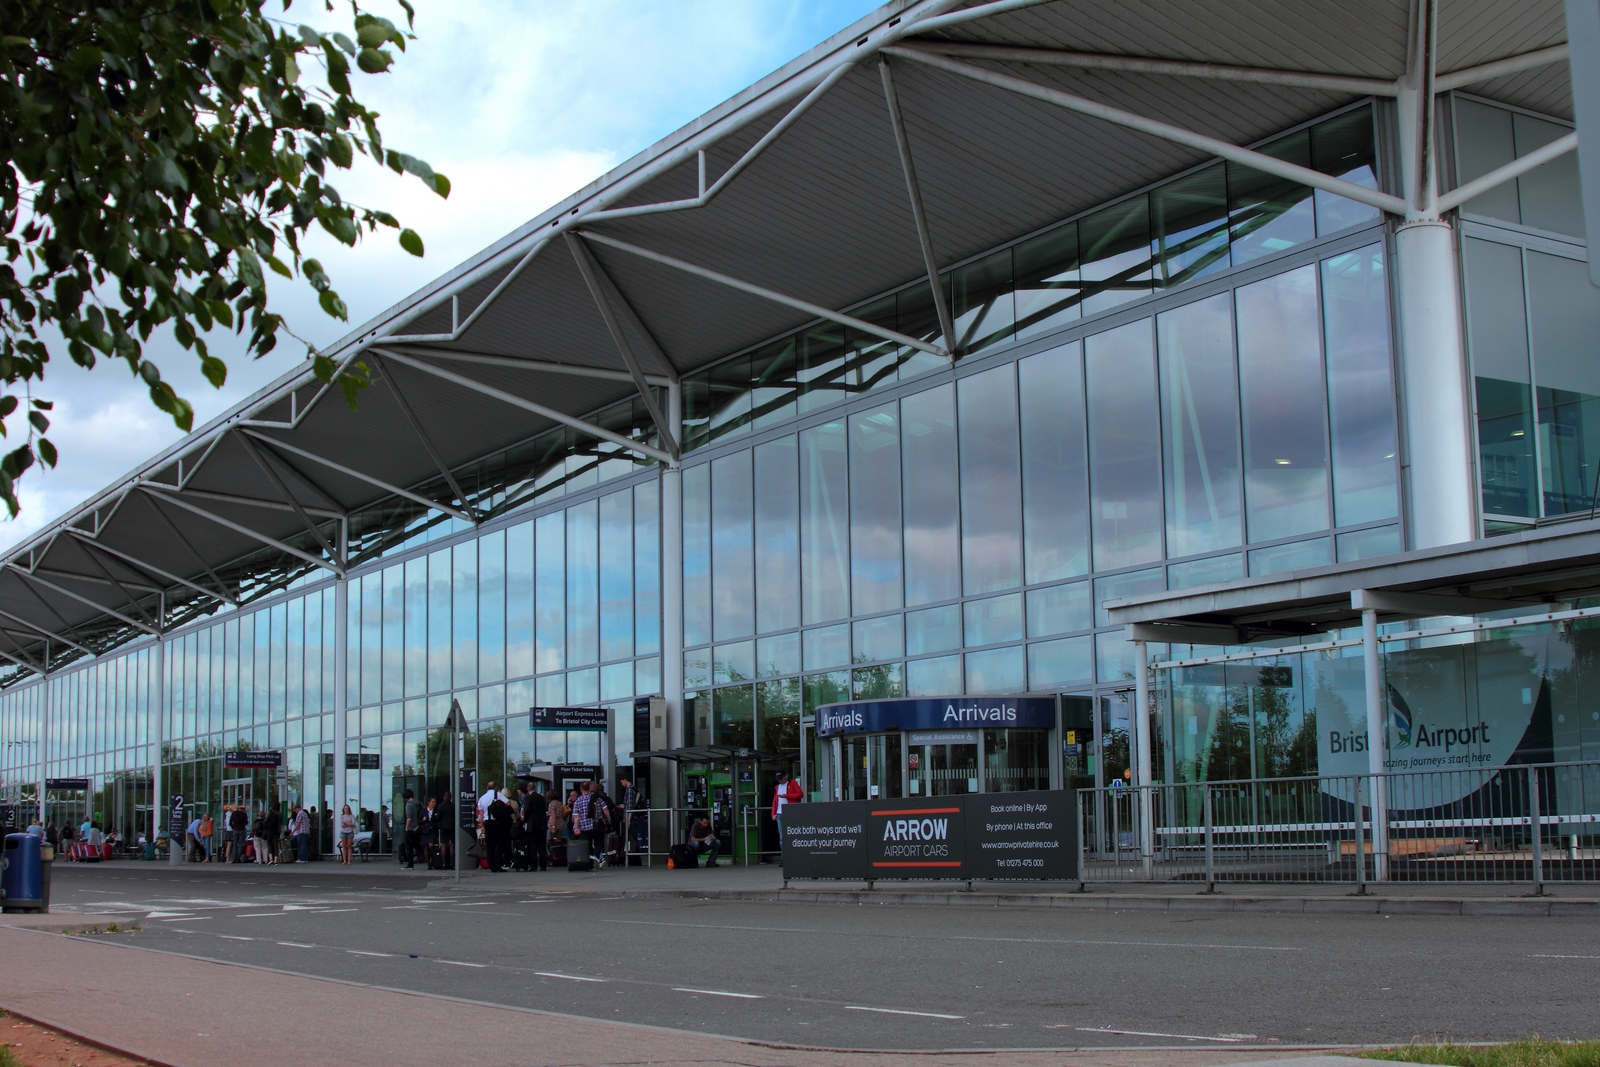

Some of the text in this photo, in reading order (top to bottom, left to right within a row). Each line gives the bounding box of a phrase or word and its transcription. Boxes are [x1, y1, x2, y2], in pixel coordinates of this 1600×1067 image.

[542, 708, 546, 716] 1
[943, 704, 1016, 721] Arrivals
[823, 710, 862, 729] Arrivals
[1416, 721, 1490, 752] Airport
[1410, 757, 1445, 768] journeys
[1448, 755, 1468, 763] start
[1472, 753, 1490, 762] here
[470, 771, 475, 791] 1
[175, 796, 183, 810] 2
[1027, 804, 1034, 812] By
[1035, 804, 1047, 812] App
[8, 810, 15, 821] 3
[802, 826, 816, 834] both
[817, 827, 834, 836] ways
[834, 825, 846, 833] and
[848, 824, 862, 833] we'll
[883, 818, 947, 841] ARROW
[986, 824, 994, 832] By
[995, 823, 1013, 832] phone
[792, 838, 856, 848] discount your journey
[982, 841, 1059, 849] www.arrowprivatehire.co.uk
[884, 844, 948, 857] AIRPORT CARS
